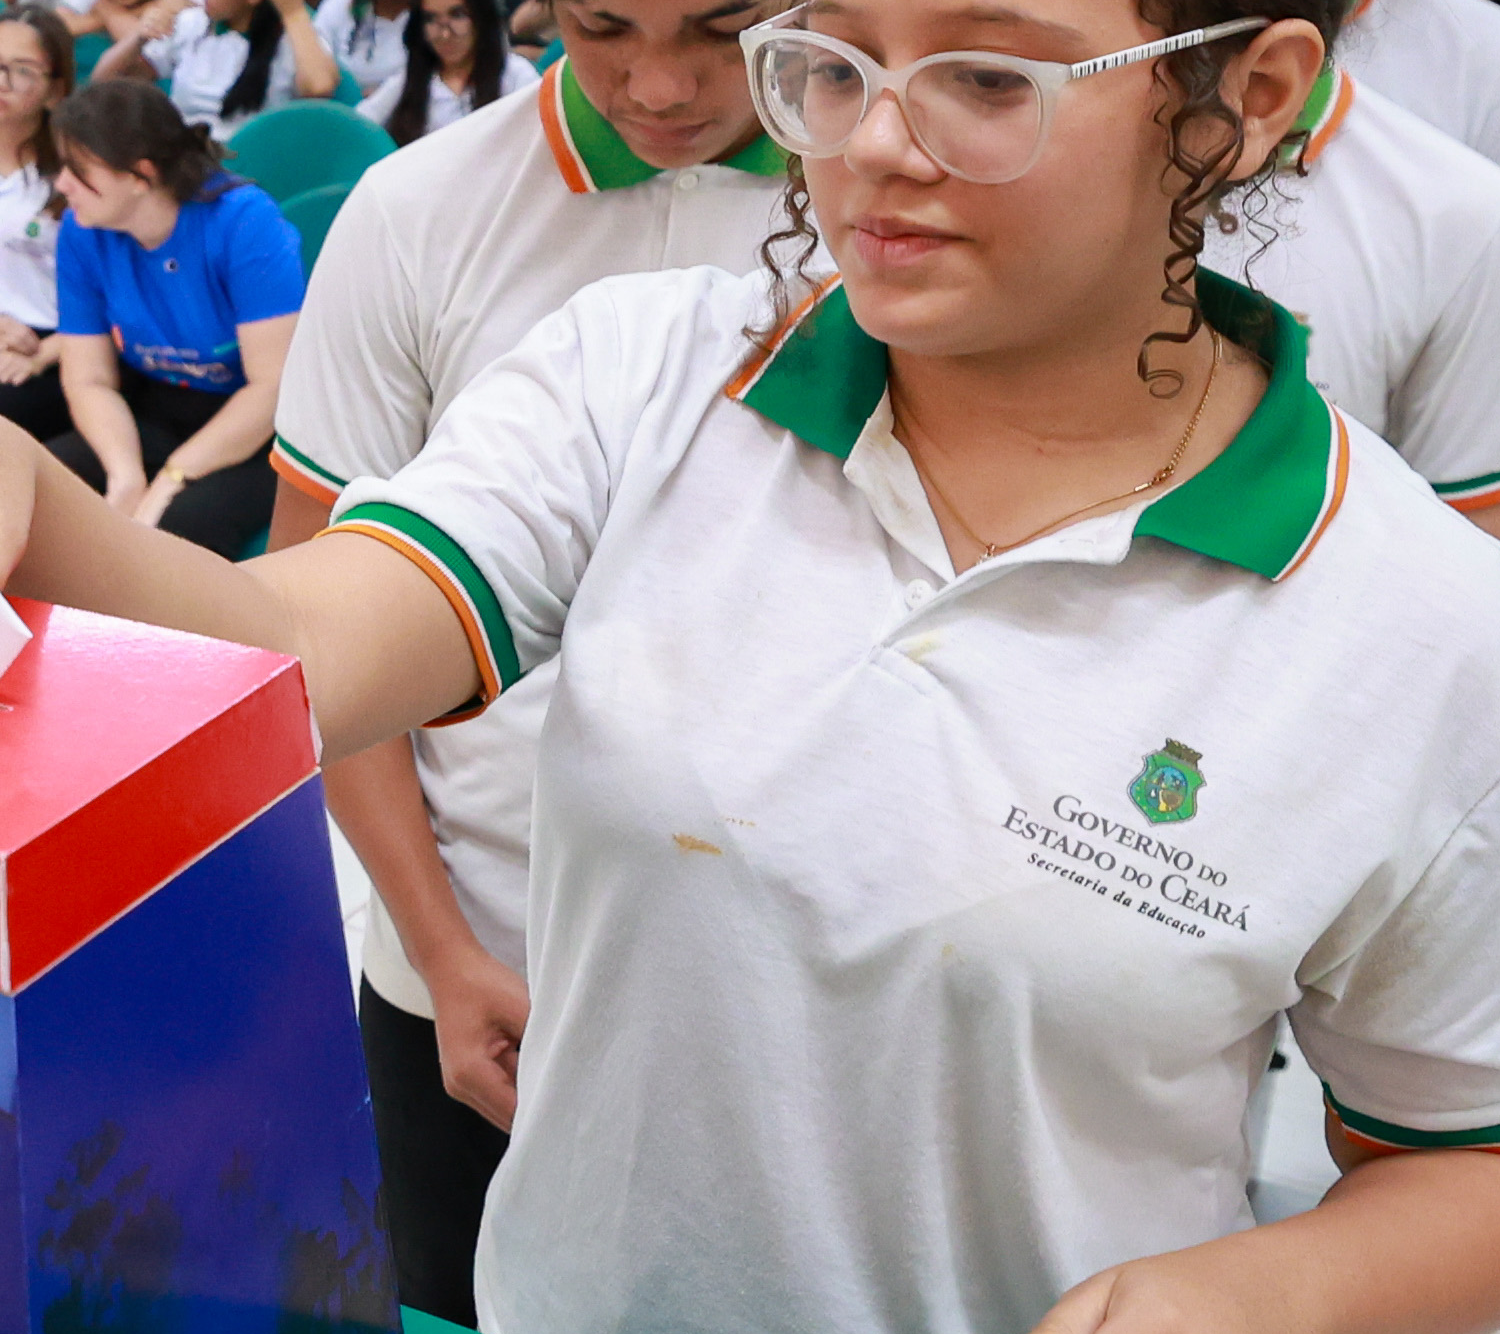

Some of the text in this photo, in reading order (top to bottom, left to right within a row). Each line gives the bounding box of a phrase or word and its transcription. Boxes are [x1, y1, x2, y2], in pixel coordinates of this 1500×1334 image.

[1001, 805, 1249, 932] ESTADO DO CEARÁ
[1052, 794, 1228, 888] GOVERNO DO
[1027, 852, 1206, 940] Secretaria da Educação
